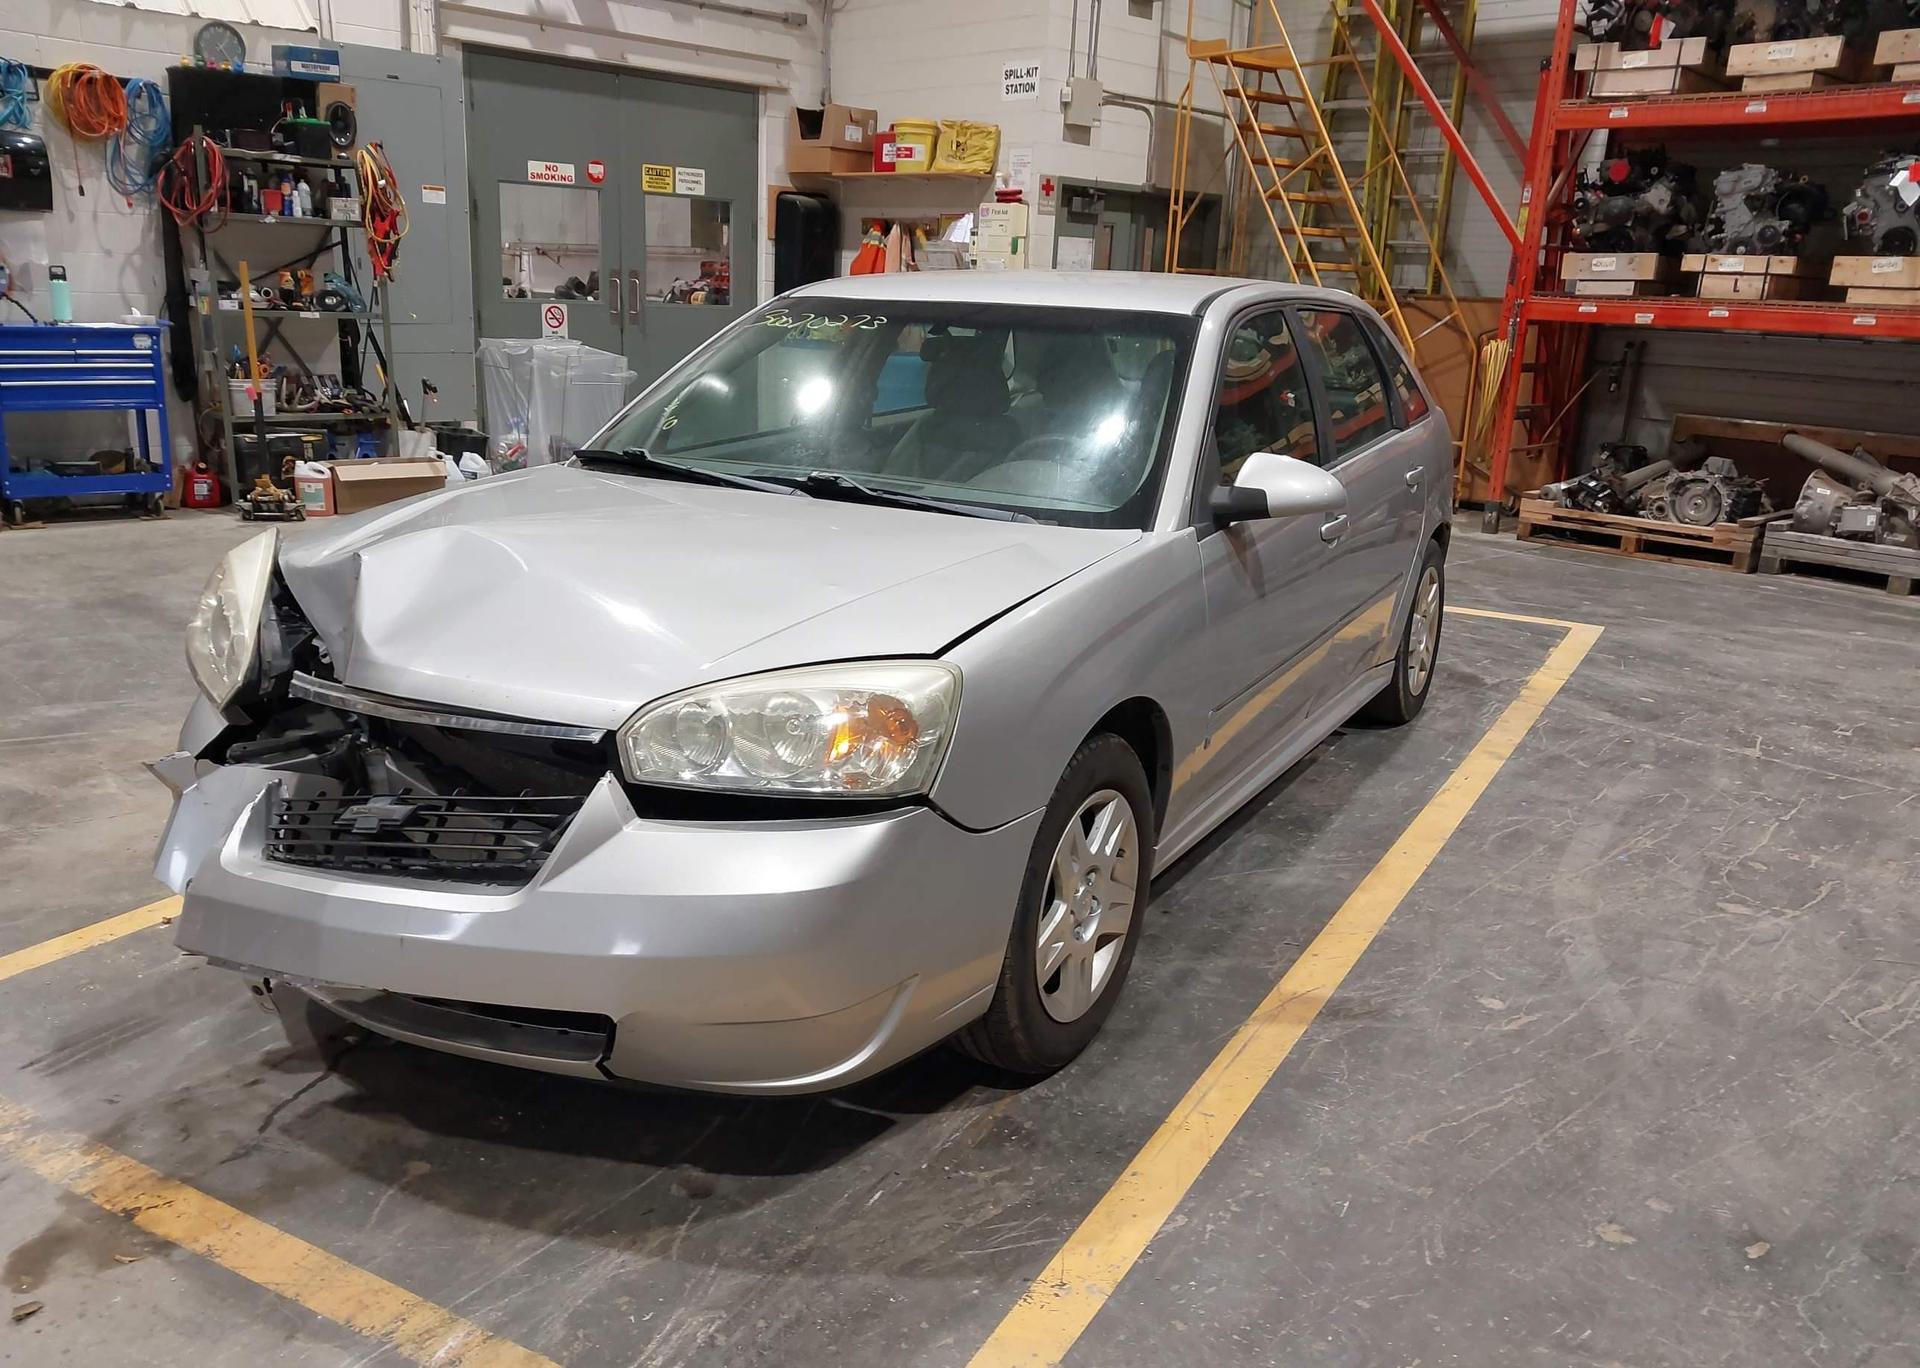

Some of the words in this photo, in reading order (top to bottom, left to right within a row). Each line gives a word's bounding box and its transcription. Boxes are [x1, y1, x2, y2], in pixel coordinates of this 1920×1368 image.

[1004, 66, 1039, 80] SPILL-KIT
[1005, 82, 1035, 95] STATION
[545, 164, 559, 172] NO
[645, 167, 670, 177] CAUTION
[530, 172, 573, 182] SMOKING
